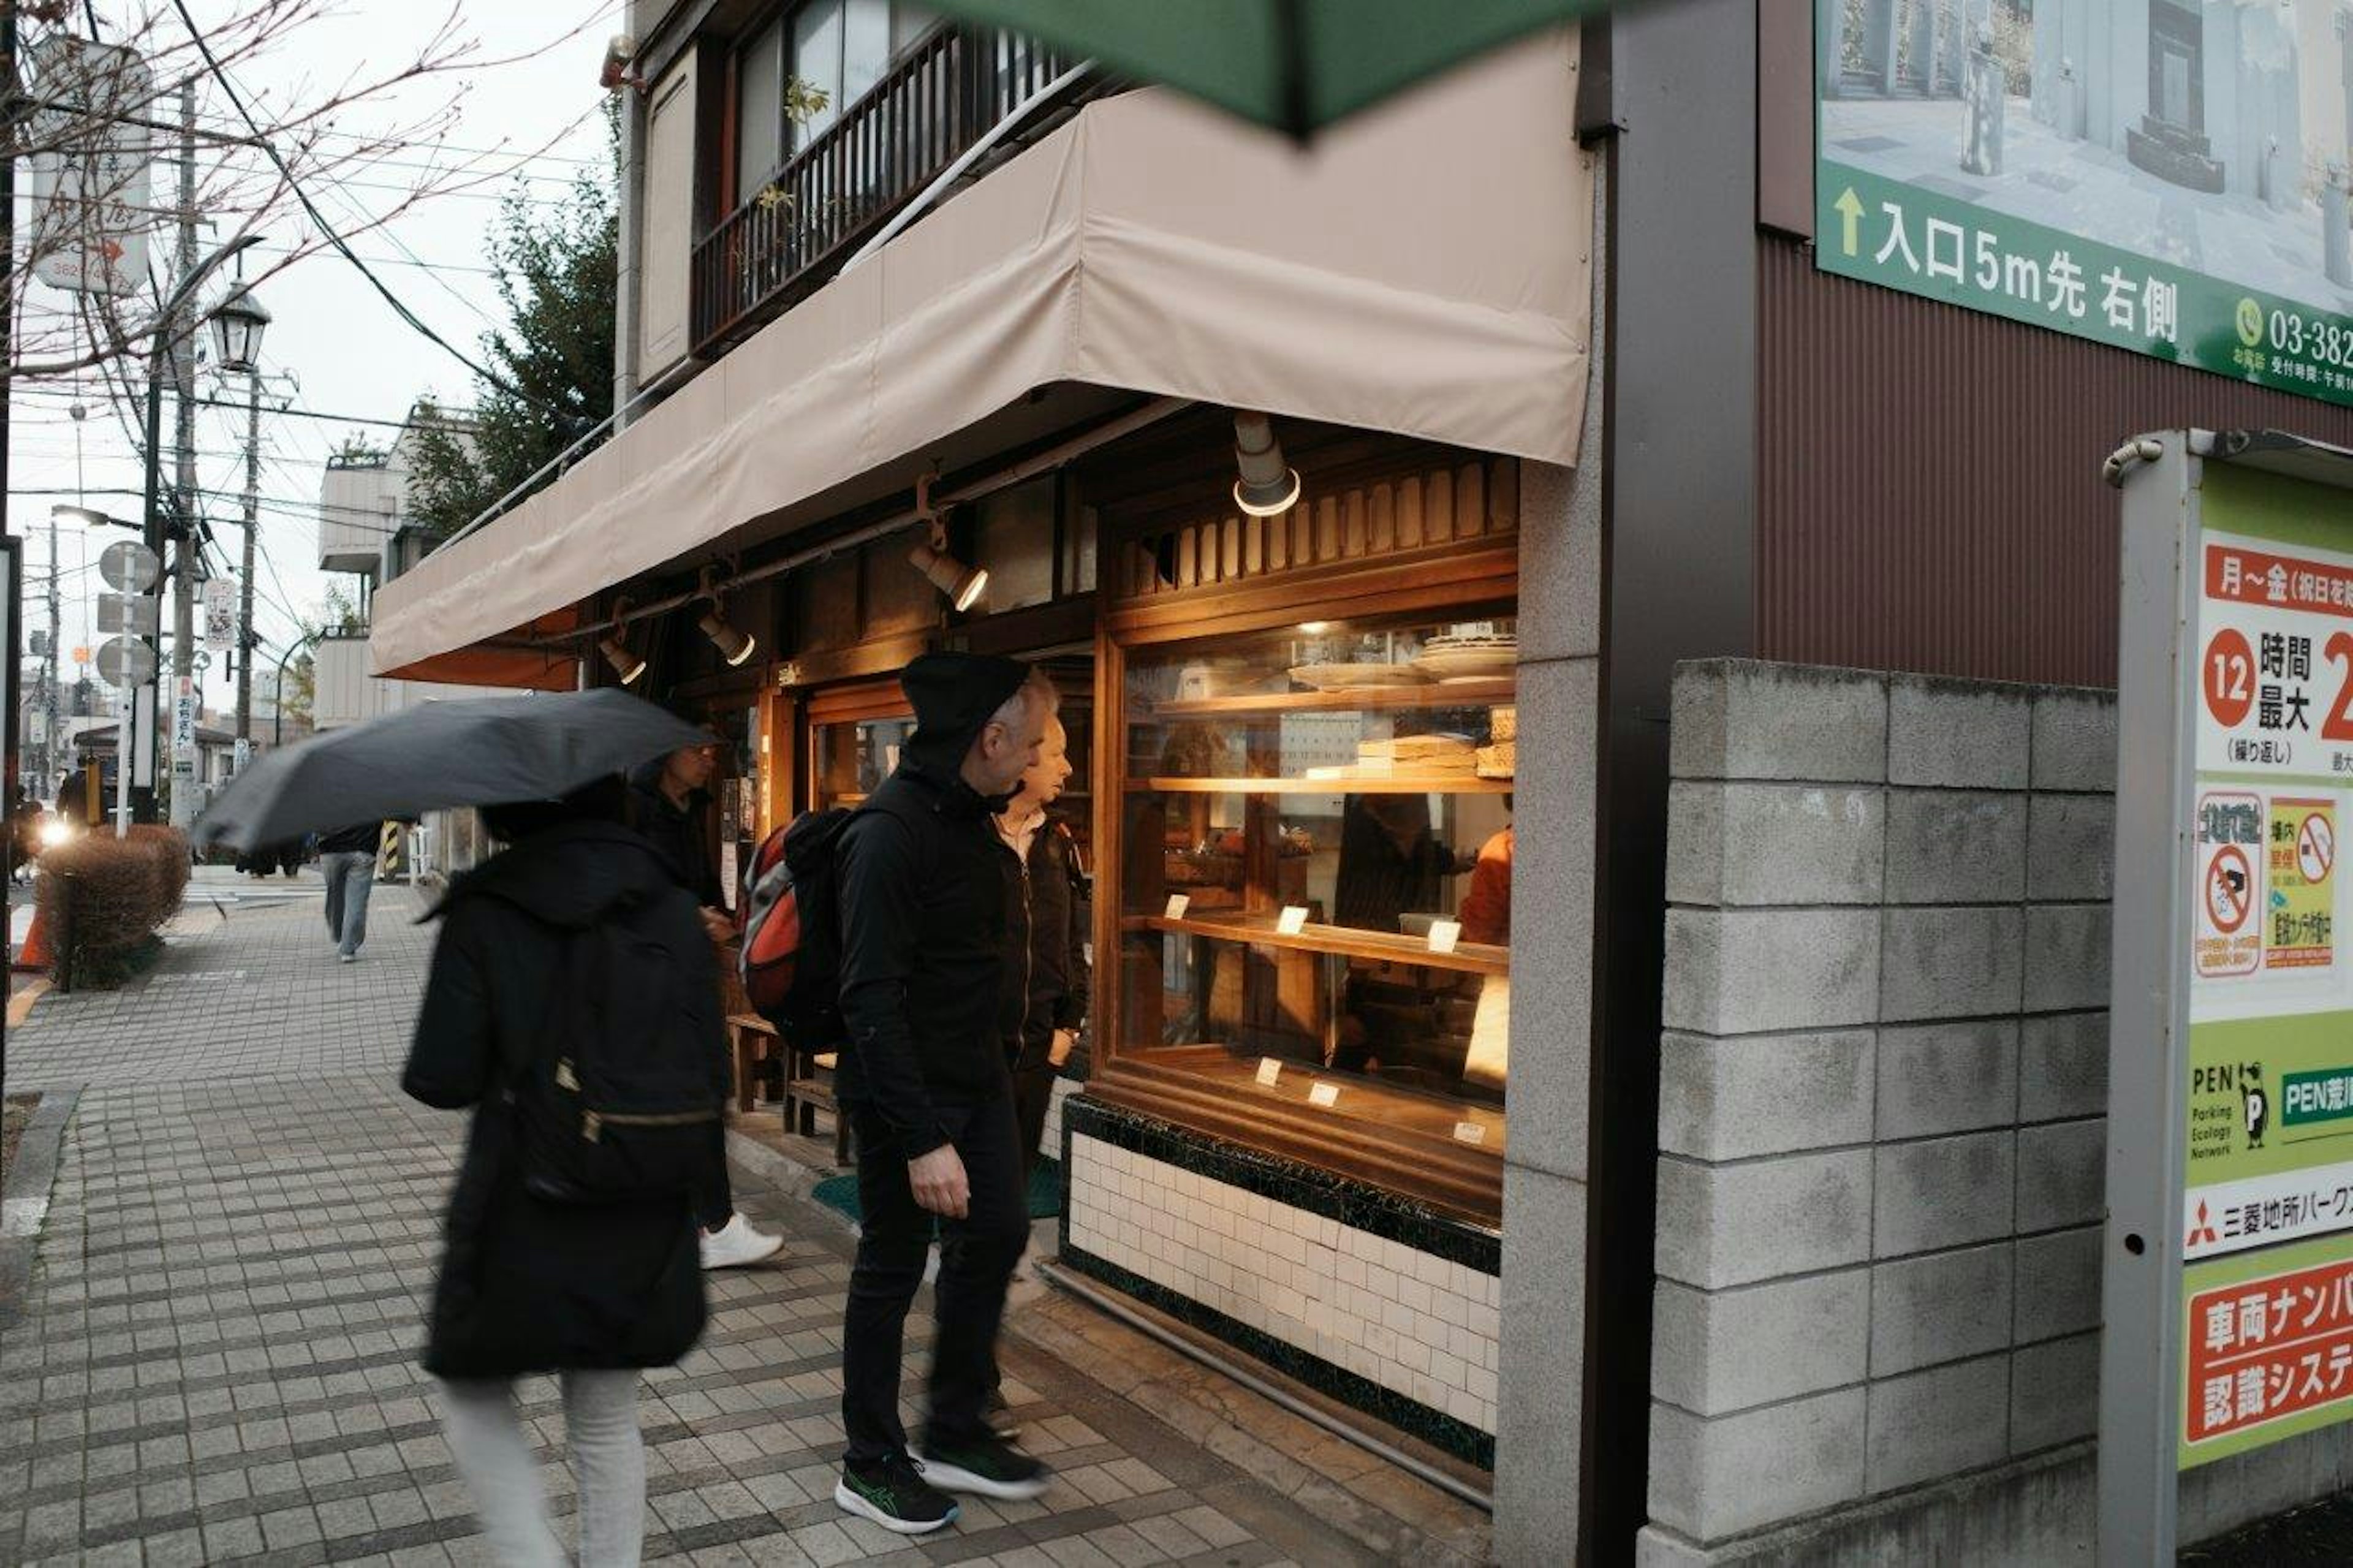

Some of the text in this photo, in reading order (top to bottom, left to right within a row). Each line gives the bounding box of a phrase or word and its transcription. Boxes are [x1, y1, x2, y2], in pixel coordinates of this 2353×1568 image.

[1875, 202, 2178, 343] 入口5m先 右側
[2214, 653, 2248, 702] 12
[2260, 632, 2311, 682] 時間
[2259, 684, 2309, 733] 最大
[2227, 738, 2292, 765] (繰り返し)
[2193, 1065, 2233, 1095] PEN
[2192, 1105, 2232, 1122] Parking
[2192, 1125, 2231, 1142] Ecology
[2191, 1146, 2231, 1161] Network
[2224, 1186, 2353, 1239] 三菱地所パーク
[2206, 1271, 2353, 1352] 車両ナンバ
[2204, 1343, 2352, 1431] 認識システ
